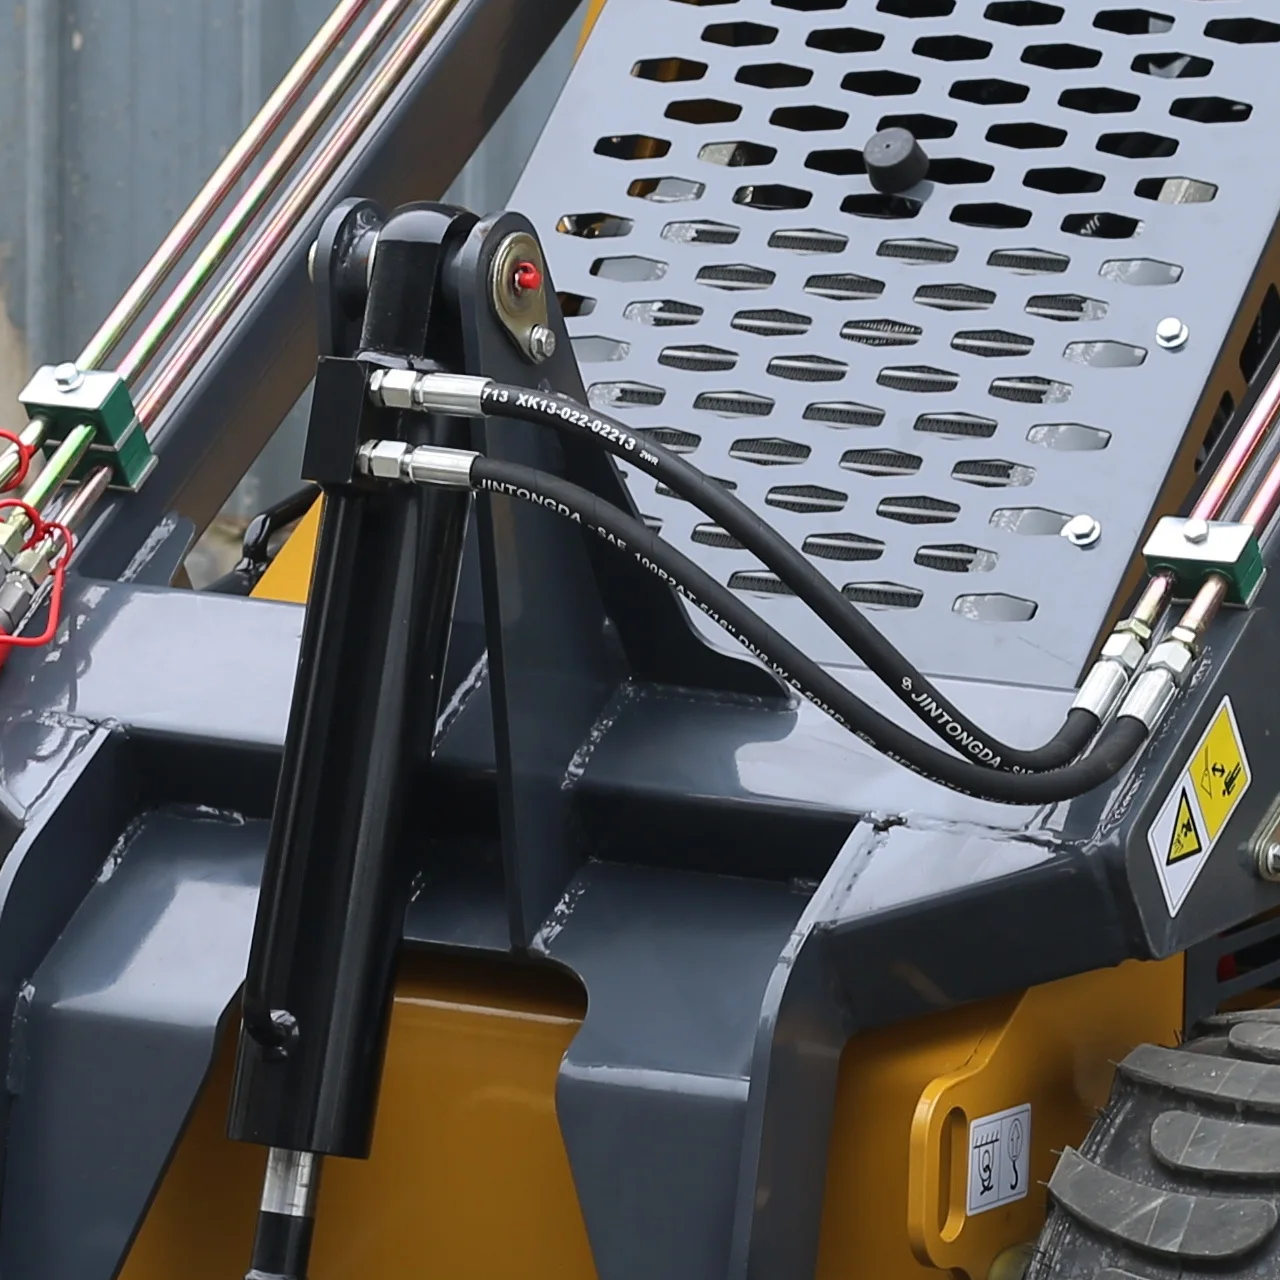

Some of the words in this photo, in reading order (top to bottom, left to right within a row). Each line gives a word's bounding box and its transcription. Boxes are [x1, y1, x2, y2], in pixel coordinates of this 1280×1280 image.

[515, 392, 637, 451] XK13-022-02213
[477, 478, 582, 524] JINTONGDA
[911, 693, 1002, 768] JINTONGDA
